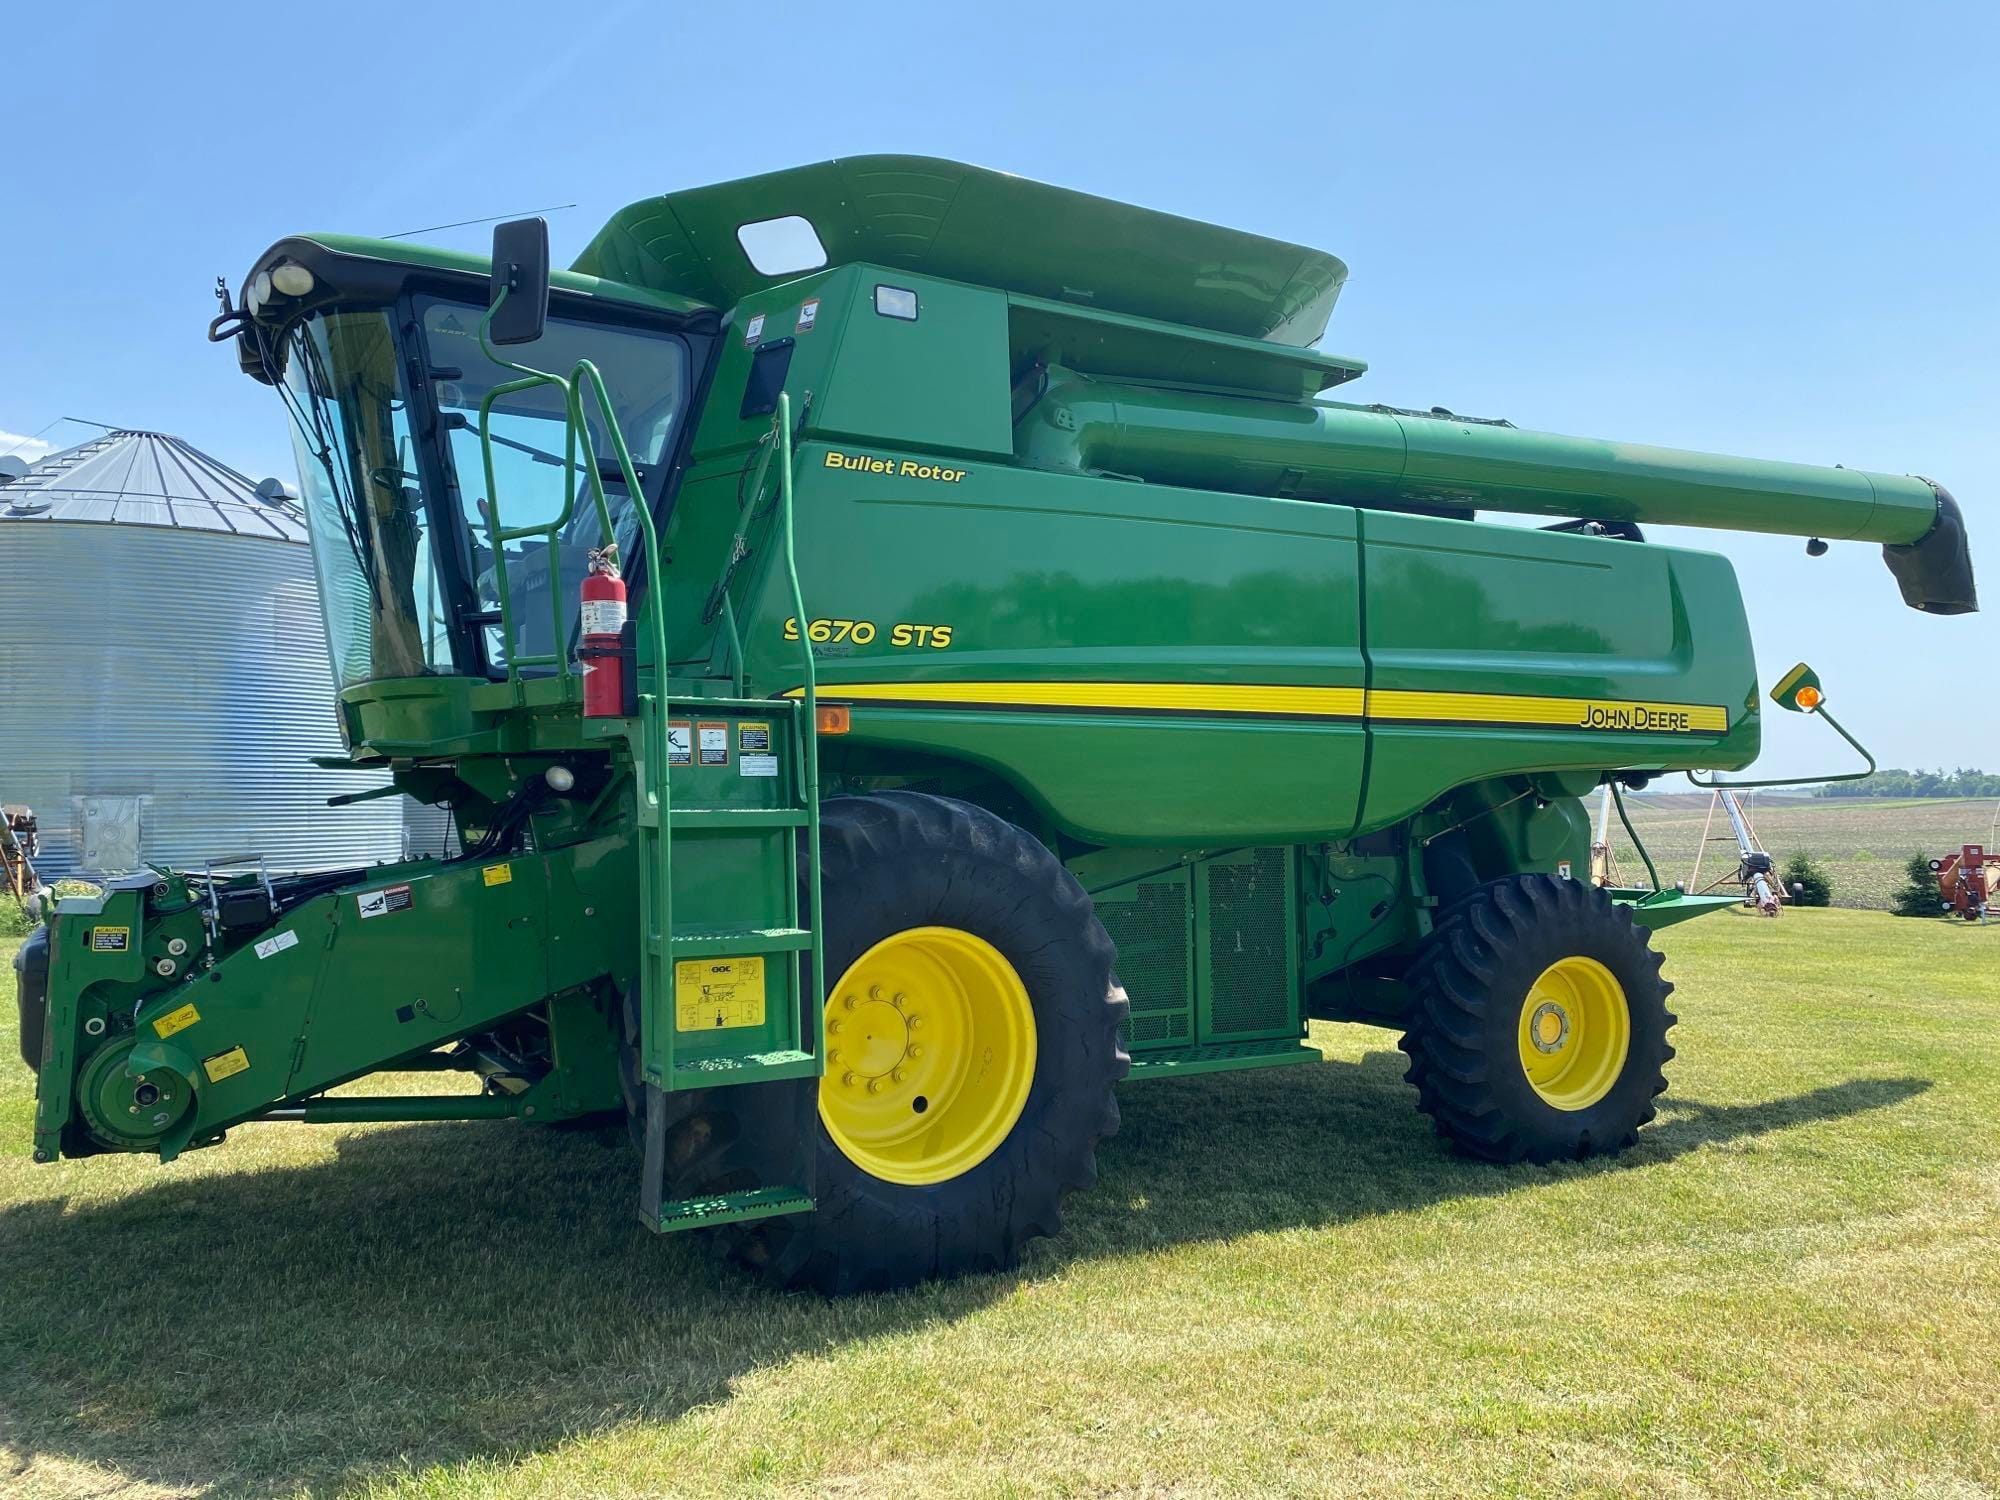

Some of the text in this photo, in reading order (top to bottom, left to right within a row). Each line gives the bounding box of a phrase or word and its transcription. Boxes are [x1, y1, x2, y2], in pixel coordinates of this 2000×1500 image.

[825, 451, 967, 483] Bullet Rotor
[890, 623, 953, 648] STS
[1580, 704, 1689, 729] JOHN DEERE
